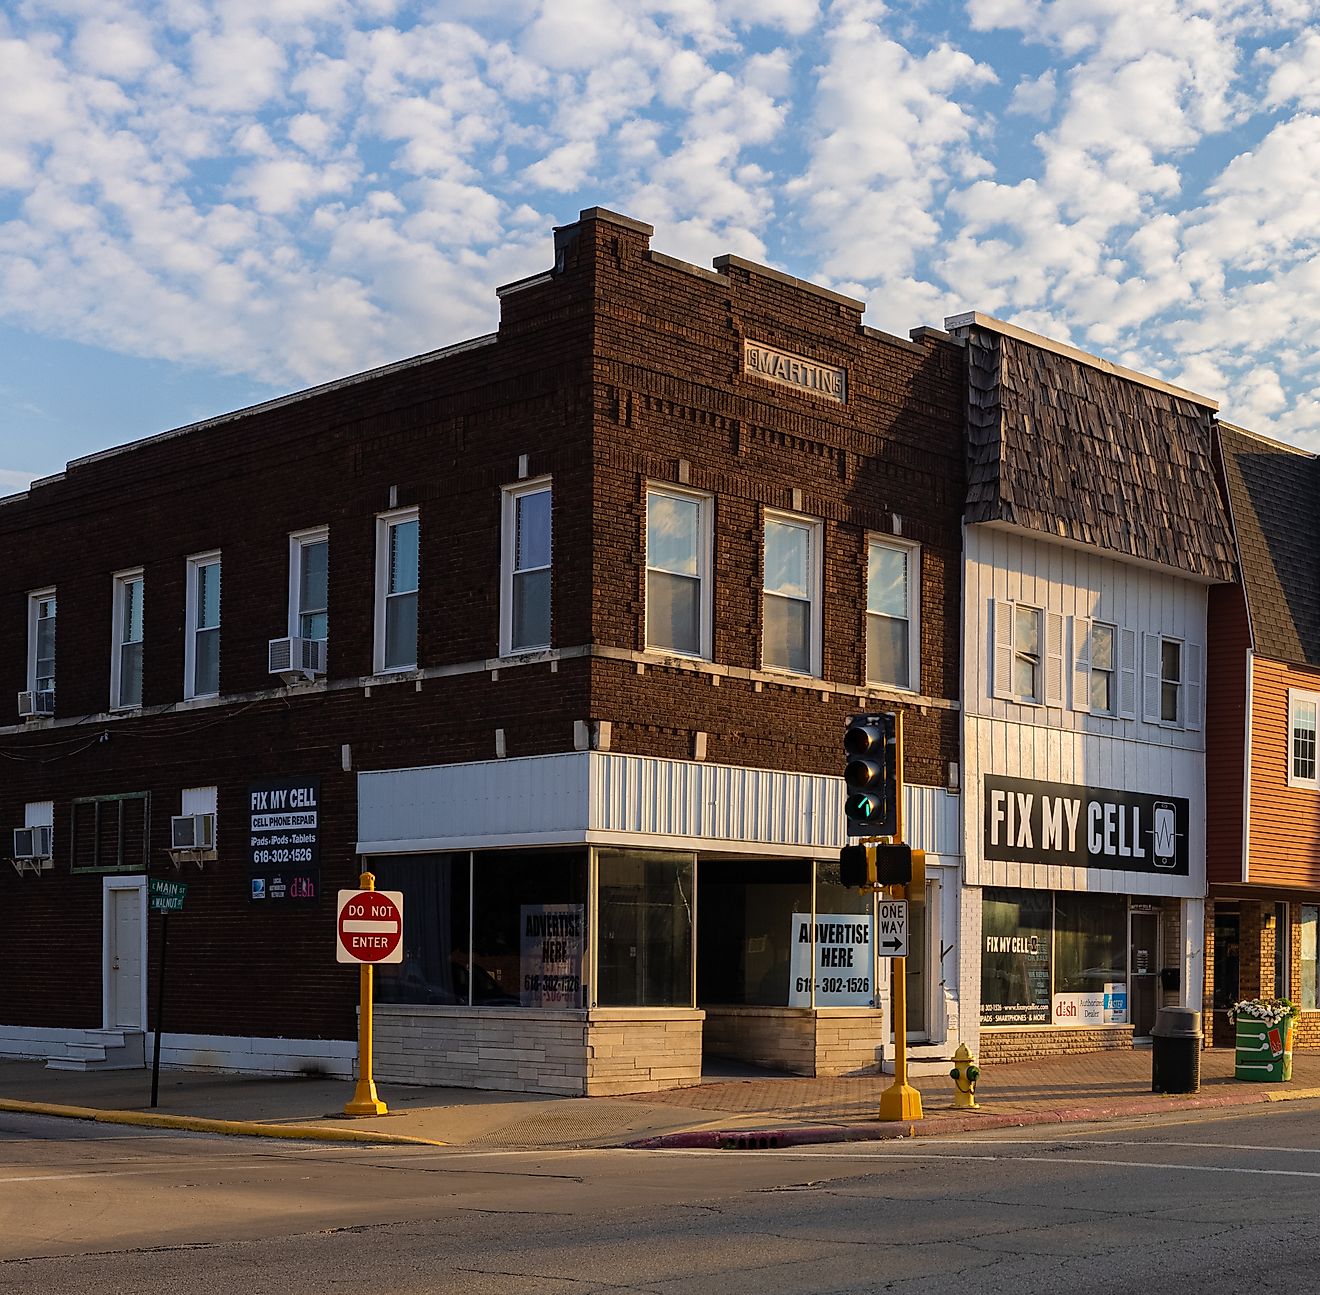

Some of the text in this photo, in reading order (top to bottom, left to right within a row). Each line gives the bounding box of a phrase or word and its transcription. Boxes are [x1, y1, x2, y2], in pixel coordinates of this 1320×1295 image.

[760, 352, 832, 393] MARTIN
[251, 787, 316, 810] FIX MY CELL
[252, 814, 315, 828] CELL PHONE REPAIR
[990, 789, 1146, 858] FIX MY CELL
[253, 847, 312, 864] 618-302-1526
[156, 882, 178, 894] MAIN
[155, 898, 178, 908] WALNUT
[349, 905, 393, 917] DO NOT
[881, 904, 905, 919] ONE
[526, 914, 580, 937] ADVERTISE
[799, 923, 869, 944] ADVERTISE
[881, 920, 905, 935] WAY
[352, 936, 388, 948] ENTER
[987, 936, 999, 953] FIX
[999, 936, 1012, 953] MY
[1012, 937, 1029, 953] CELL
[542, 941, 568, 964] HERE
[821, 947, 853, 967] HERE
[822, 978, 869, 993] 302-1526
[1056, 1001, 1077, 1017] dish
[1084, 1009, 1100, 1018] Dealer
